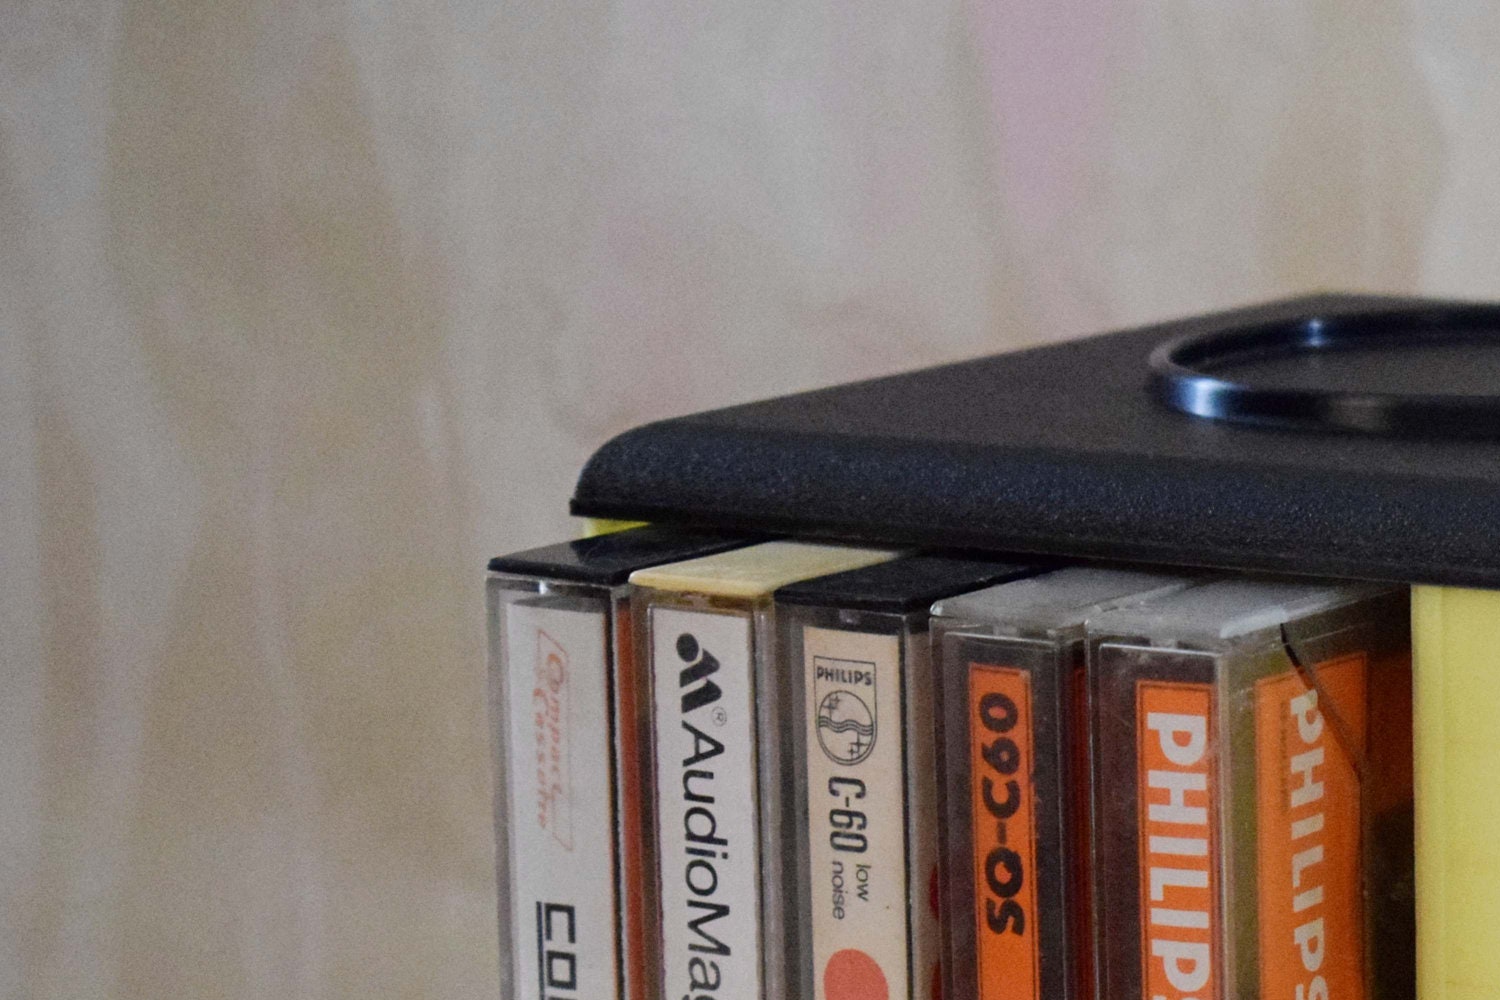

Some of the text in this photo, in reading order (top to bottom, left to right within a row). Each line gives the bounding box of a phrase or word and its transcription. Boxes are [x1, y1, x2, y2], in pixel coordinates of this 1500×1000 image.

[816, 666, 873, 687] PHILIPS
[828, 776, 868, 853] C-60
[831, 860, 846, 920] noise
[855, 863, 872, 902] low
